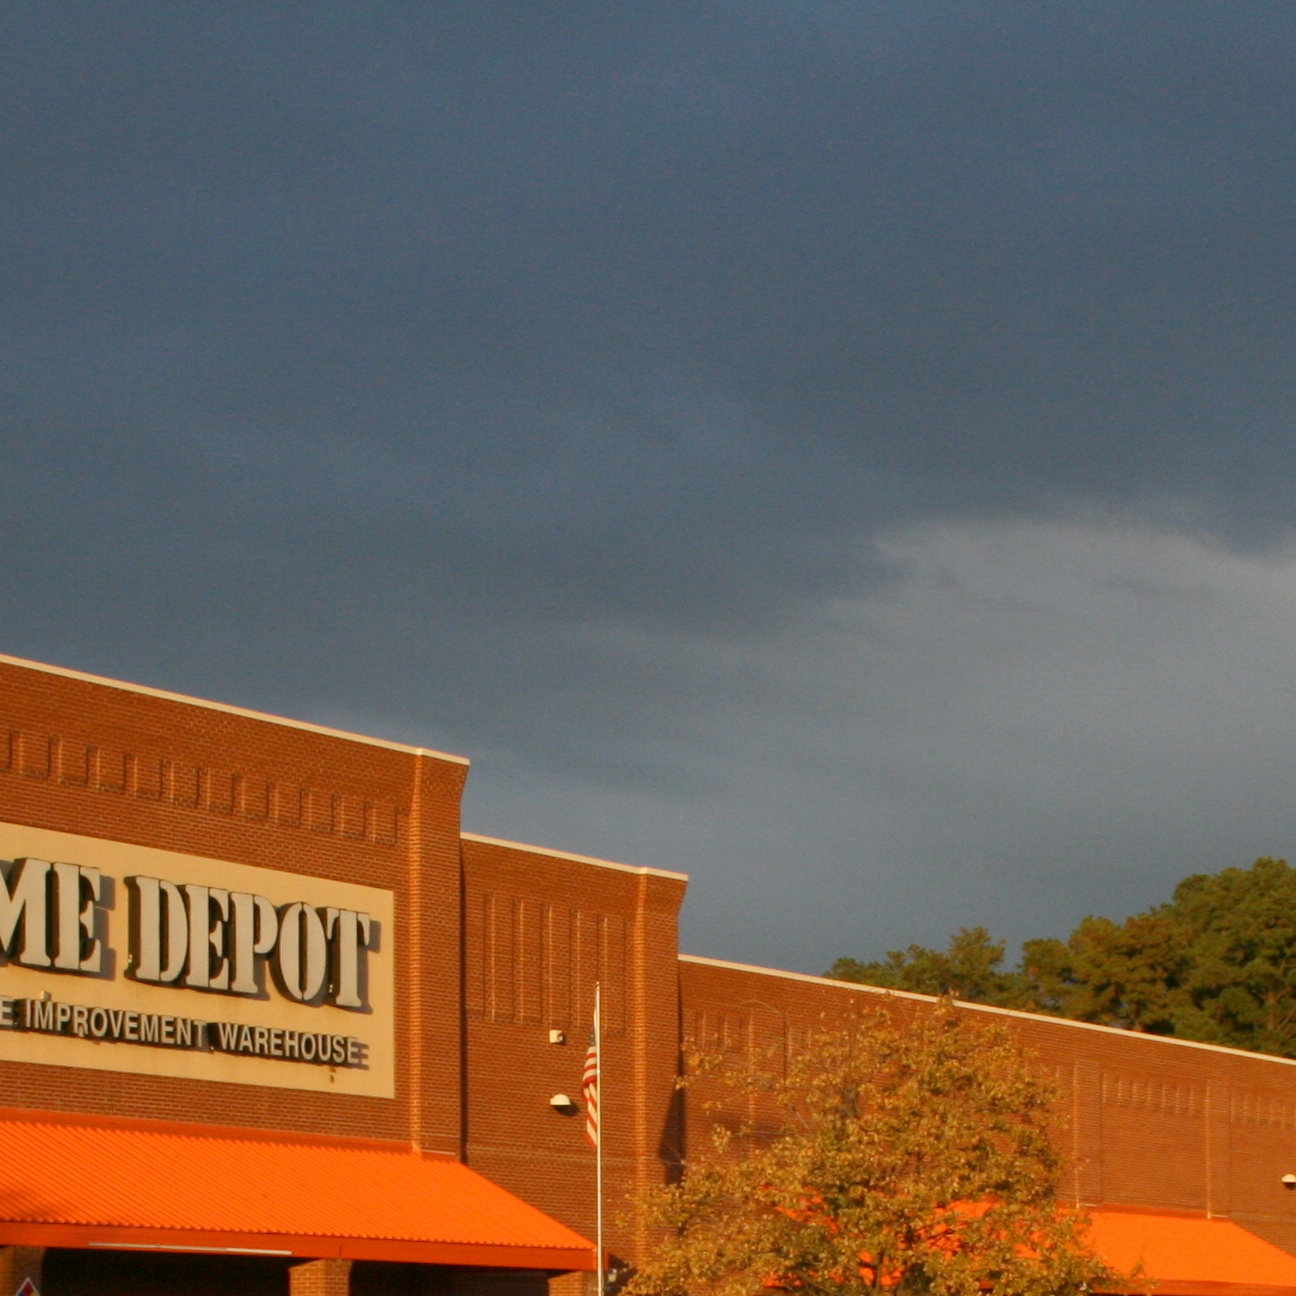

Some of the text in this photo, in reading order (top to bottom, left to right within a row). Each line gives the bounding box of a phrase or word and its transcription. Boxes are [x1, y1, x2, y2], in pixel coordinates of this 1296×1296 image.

[132, 875, 370, 1008] DEPOT
[25, 998, 207, 1047] IMPROVEMENT
[218, 1021, 360, 1065] WAREHOUSE
